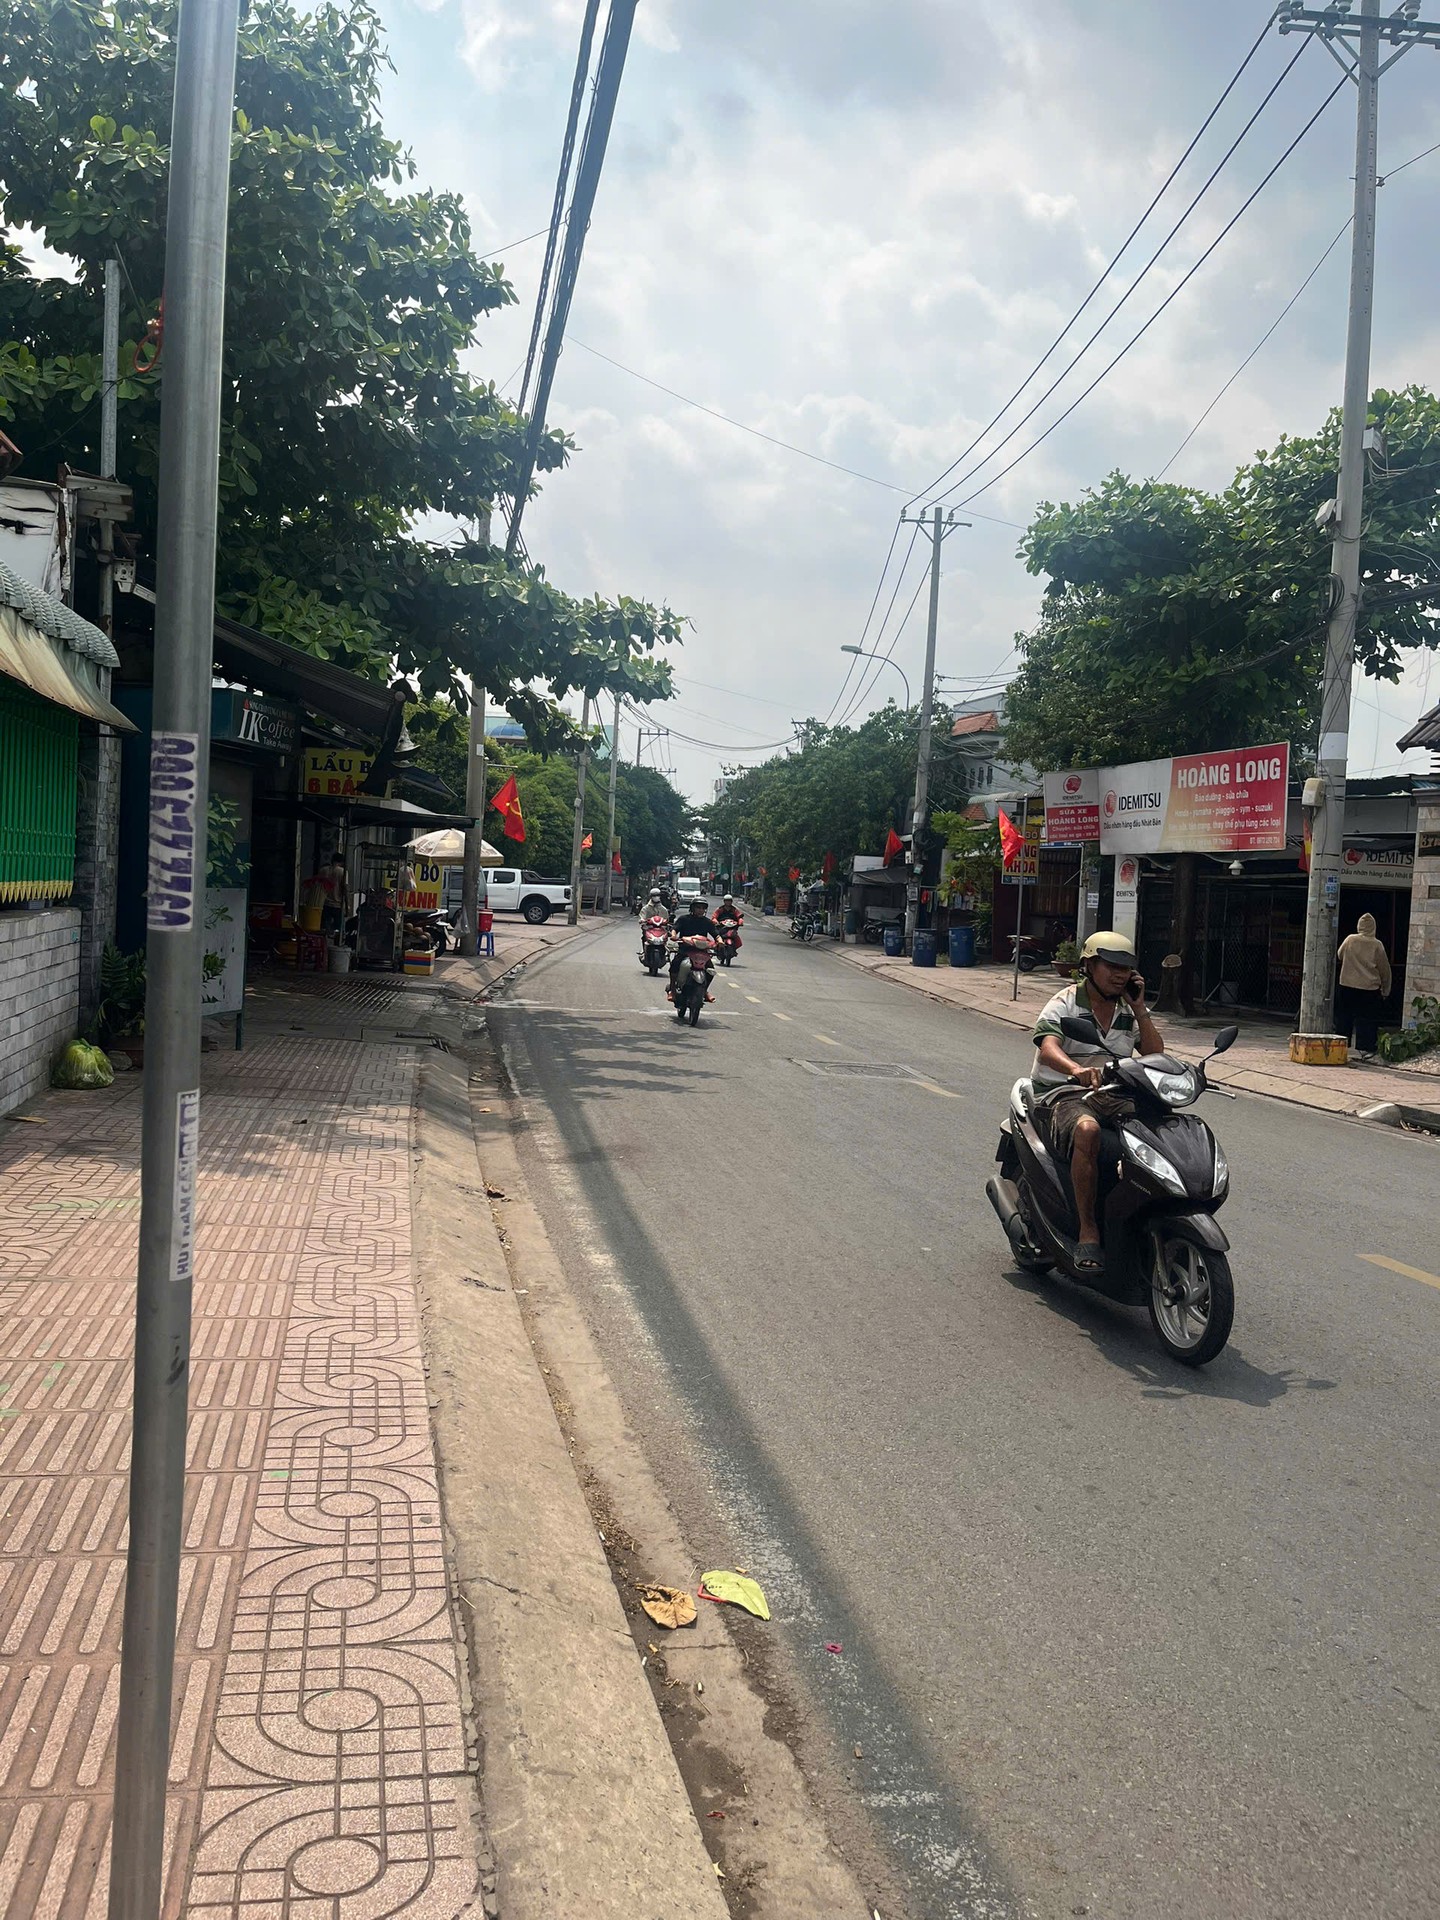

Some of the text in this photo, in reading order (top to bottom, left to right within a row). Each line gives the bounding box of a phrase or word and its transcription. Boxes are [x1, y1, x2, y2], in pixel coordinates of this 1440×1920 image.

[259, 715, 296, 739] Coffee
[263, 736, 277, 747] Take
[1177, 758, 1280, 789] HOÀNG LONG
[1118, 792, 1161, 811] IDEMITSU
[1255, 802, 1273, 812] suzuki
[1048, 815, 1099, 825] HOÀNG LONG
